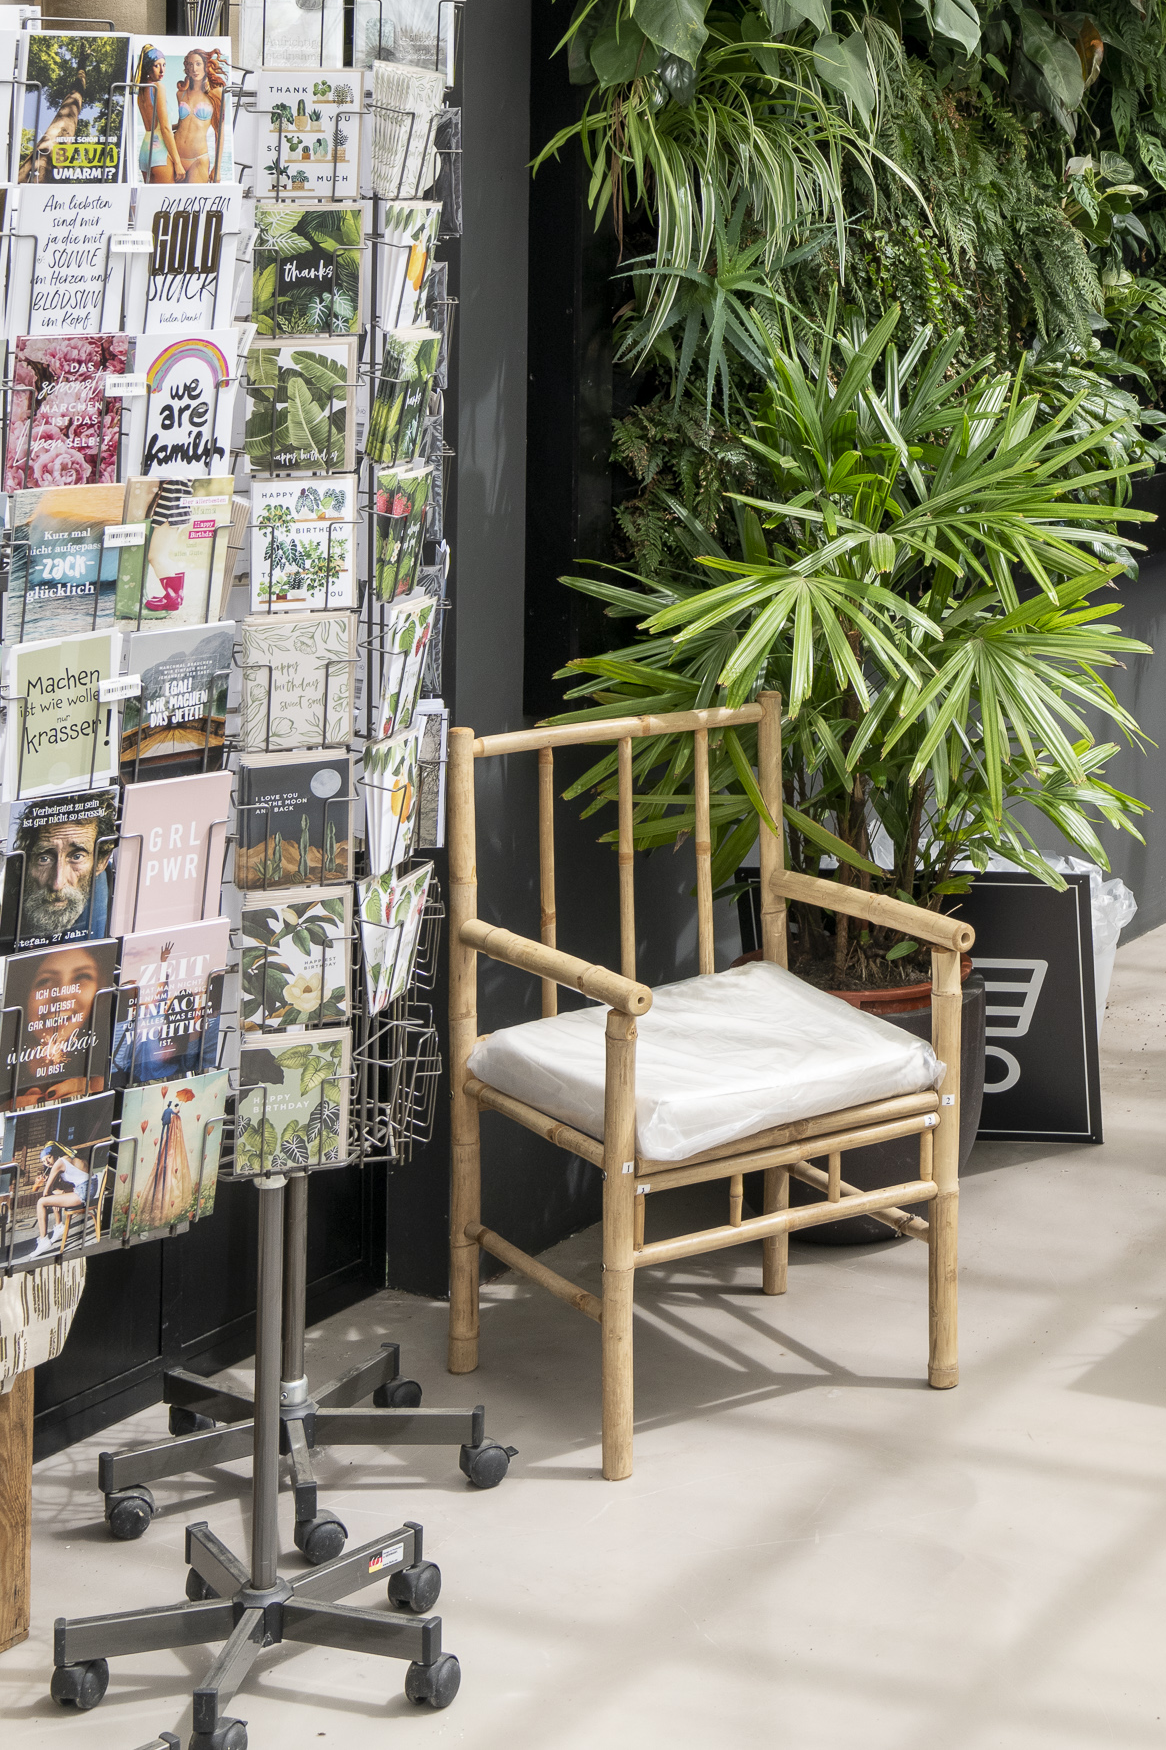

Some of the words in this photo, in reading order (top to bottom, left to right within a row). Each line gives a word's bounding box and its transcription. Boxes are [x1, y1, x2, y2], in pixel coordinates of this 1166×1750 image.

[269, 86, 308, 94] THANK
[55, 147, 115, 164] BAUM
[43, 194, 66, 213] Am
[68, 194, 113, 211] liebsten
[52, 212, 79, 229] sind
[79, 216, 101, 228] mir
[43, 233, 59, 253] ja
[61, 229, 81, 247] die
[82, 230, 104, 245] mit
[149, 210, 223, 276] GOLD
[49, 270, 88, 286] Herzen
[283, 259, 333, 282] thanks
[41, 316, 58, 327] im
[61, 310, 93, 331] Kopf.
[159, 312, 180, 324] Vielen
[70, 362, 95, 372] DAS
[170, 378, 204, 401] we
[40, 400, 103, 414] MÄRCHEN
[51, 416, 71, 427] IST
[74, 414, 99, 425] DAS
[159, 401, 210, 431] are
[141, 430, 226, 477] family
[273, 452, 297, 466] appy
[261, 491, 294, 499] HAPPY
[43, 530, 69, 541] Kurz
[71, 527, 91, 538] mal
[295, 525, 344, 534] BIRTHDAY
[54, 542, 102, 554] aufgepass
[25, 581, 96, 603] glücklich
[273, 661, 301, 677] appy
[26, 667, 101, 698] Machen
[165, 677, 193, 696] EGAL!
[274, 677, 320, 693] birthday
[40, 698, 63, 713] wie
[67, 687, 100, 706] wolle
[169, 689, 208, 710] MACHEN
[280, 695, 306, 712] sweet
[56, 714, 71, 723] nur
[150, 711, 169, 728] DAS
[171, 703, 204, 724] JETZT!
[32, 803, 74, 817] Verheiratet
[74, 802, 84, 810] zu
[84, 799, 100, 808] sein
[273, 805, 294, 813] BACK
[284, 797, 308, 805] MOON
[22, 818, 33, 828] ist
[33, 817, 48, 828] gar
[48, 813, 68, 824] nicht
[68, 812, 78, 821] so
[149, 821, 201, 853] GRL
[145, 853, 199, 887] PWR
[52, 933, 62, 942] 27
[65, 929, 94, 940] Jahr.
[304, 956, 336, 965] HAPPEST
[139, 954, 210, 987] ZEIT
[35, 988, 50, 1000] ICH
[51, 983, 82, 997] GLAUBE,
[140, 986, 155, 995] HAT
[157, 983, 175, 991] MAN
[144, 992, 171, 1002] NIMMT
[173, 988, 192, 997] MAN
[38, 1005, 49, 1015] DU
[50, 999, 76, 1012] WEISST
[127, 993, 213, 1022] EINFACH,
[28, 1021, 44, 1032] GAR
[45, 1015, 69, 1029] NICHT,
[71, 1012, 84, 1023] WIE
[169, 1012, 186, 1022] WAS
[159, 1038, 174, 1048] IST.
[36, 1066, 47, 1078] DU
[48, 1063, 65, 1075] BIST.
